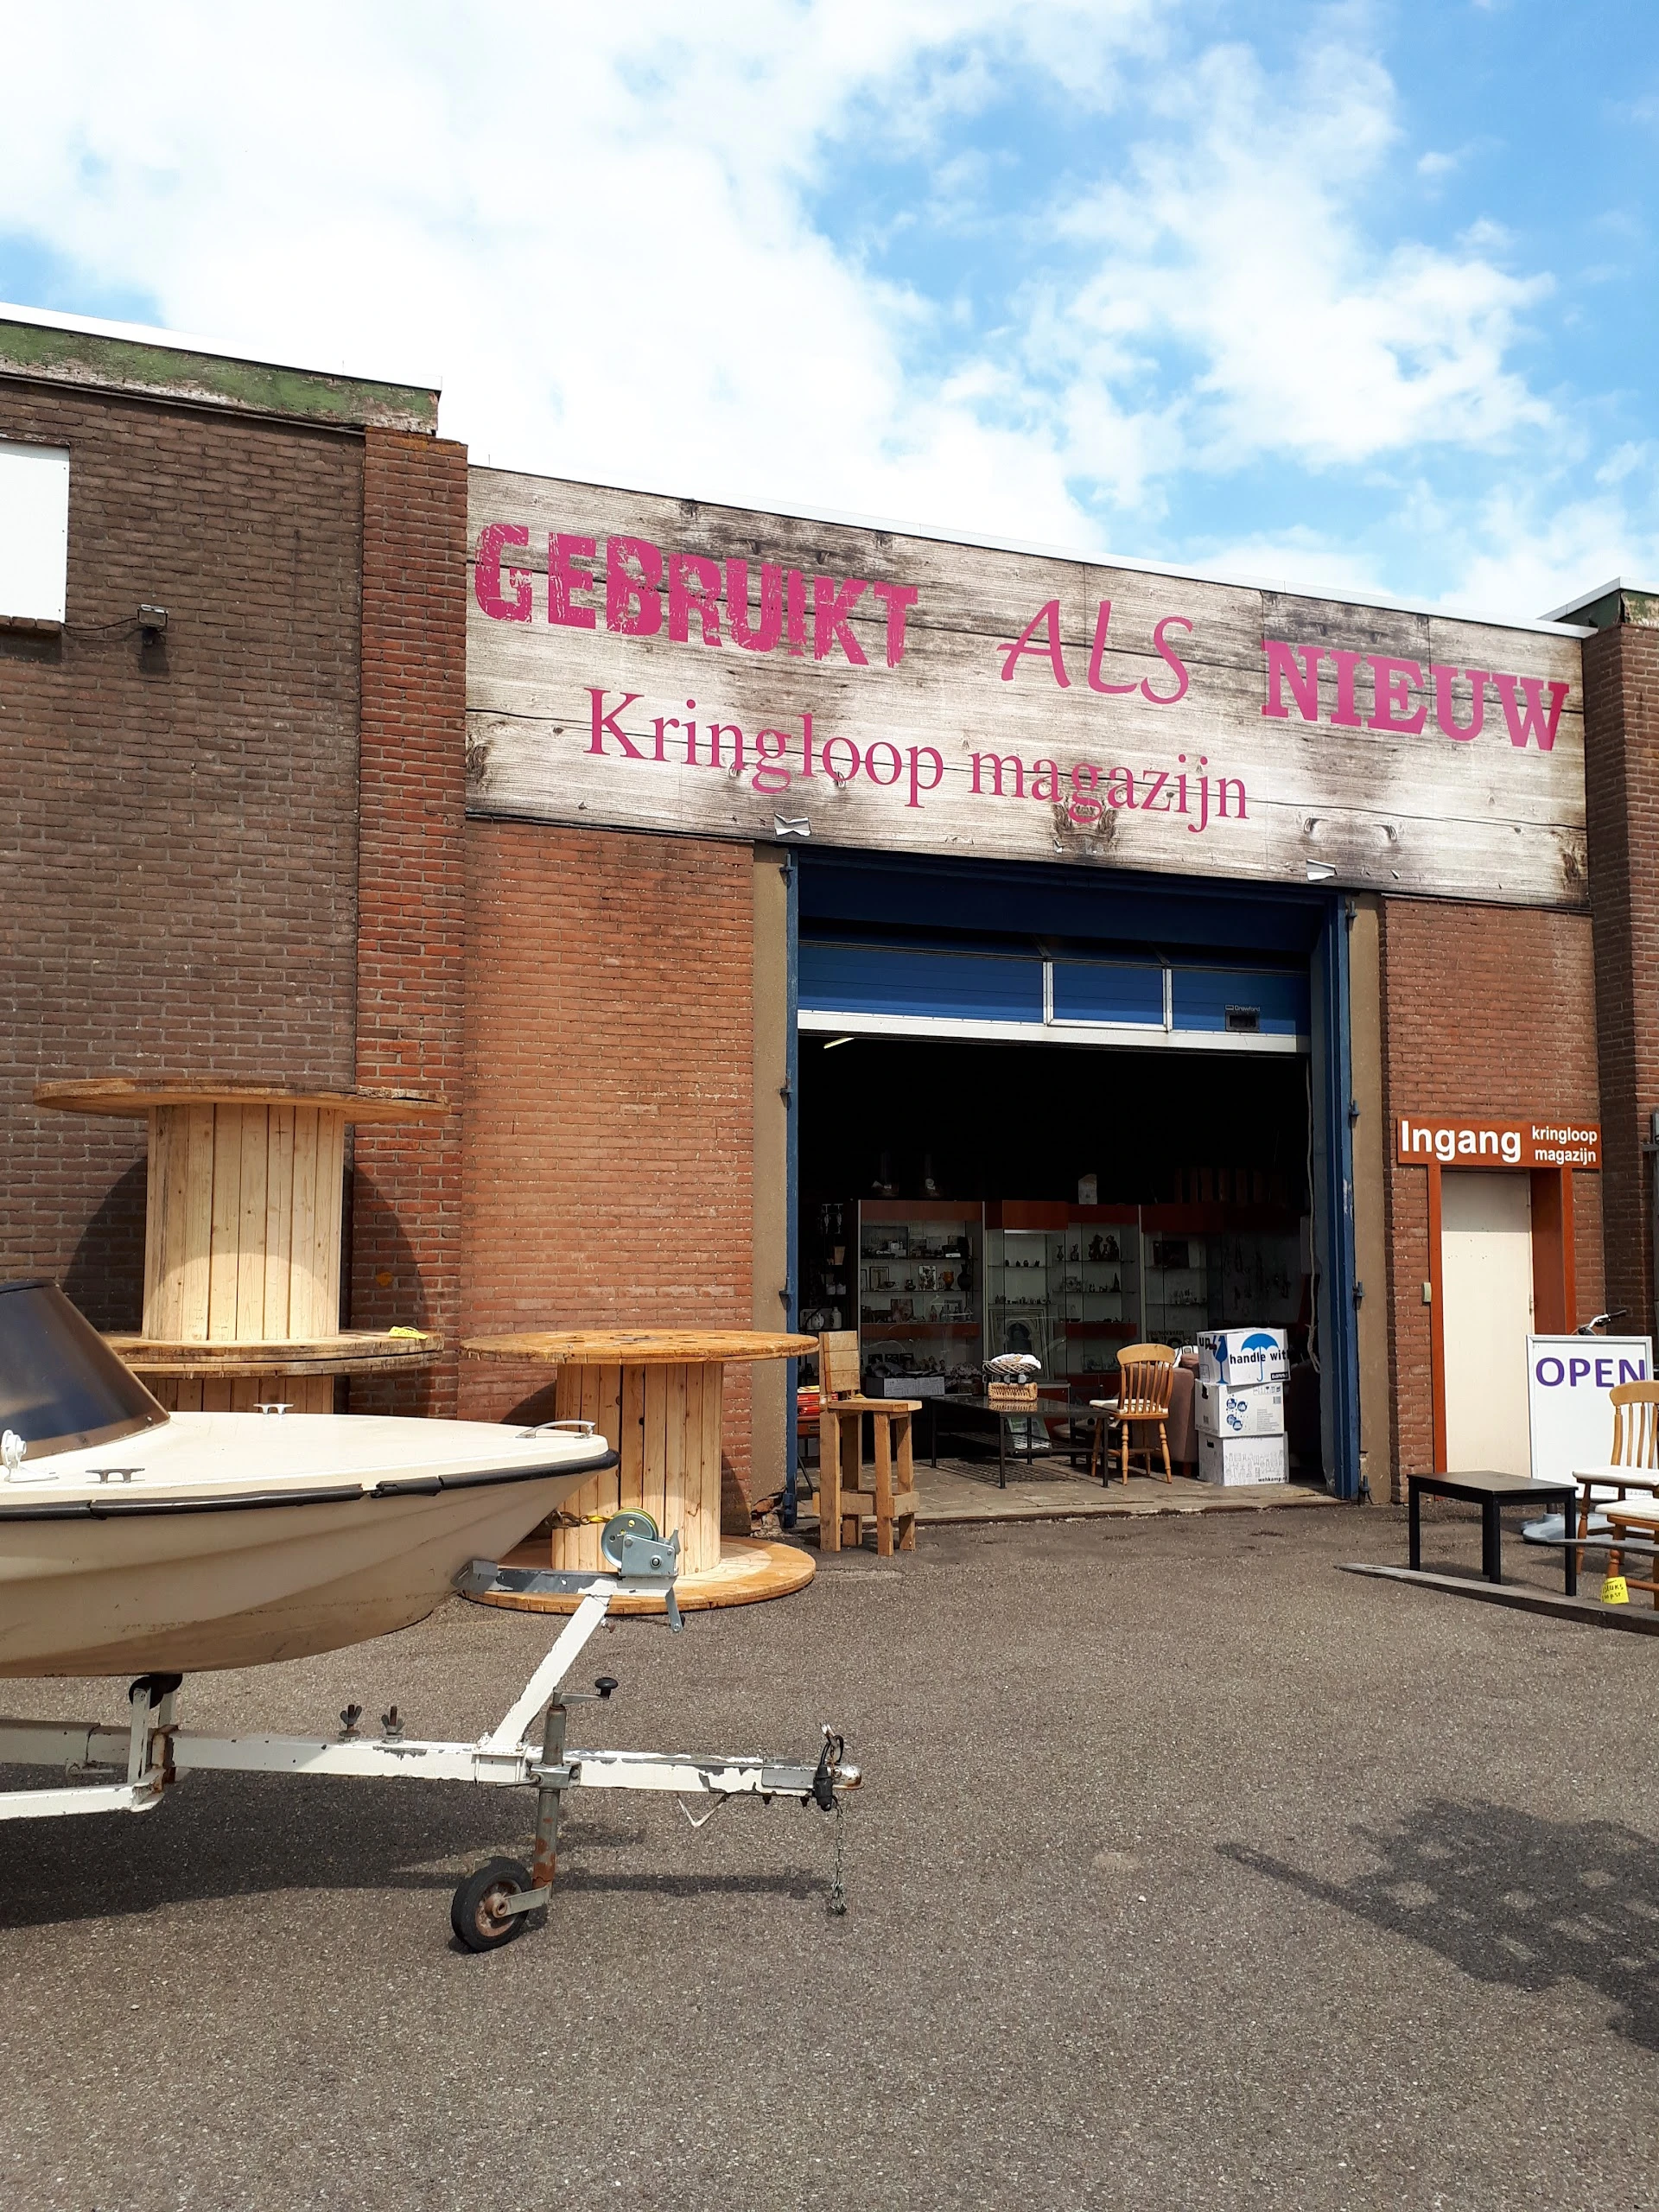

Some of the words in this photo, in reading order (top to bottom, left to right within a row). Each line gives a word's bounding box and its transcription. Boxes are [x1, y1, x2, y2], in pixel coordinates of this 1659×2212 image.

[475, 523, 918, 669] GEBRUIKT
[996, 599, 1193, 705] ALS
[1261, 639, 1570, 752] NIEUW
[583, 687, 944, 808] Kringloop
[969, 753, 1249, 833] magazijn
[1402, 1120, 1521, 1163] Ingang
[1532, 1125, 1598, 1145] kringloop
[1535, 1147, 1596, 1166] magazijn
[1230, 1351, 1266, 1365] handle
[1535, 1357, 1645, 1388] OPEN
